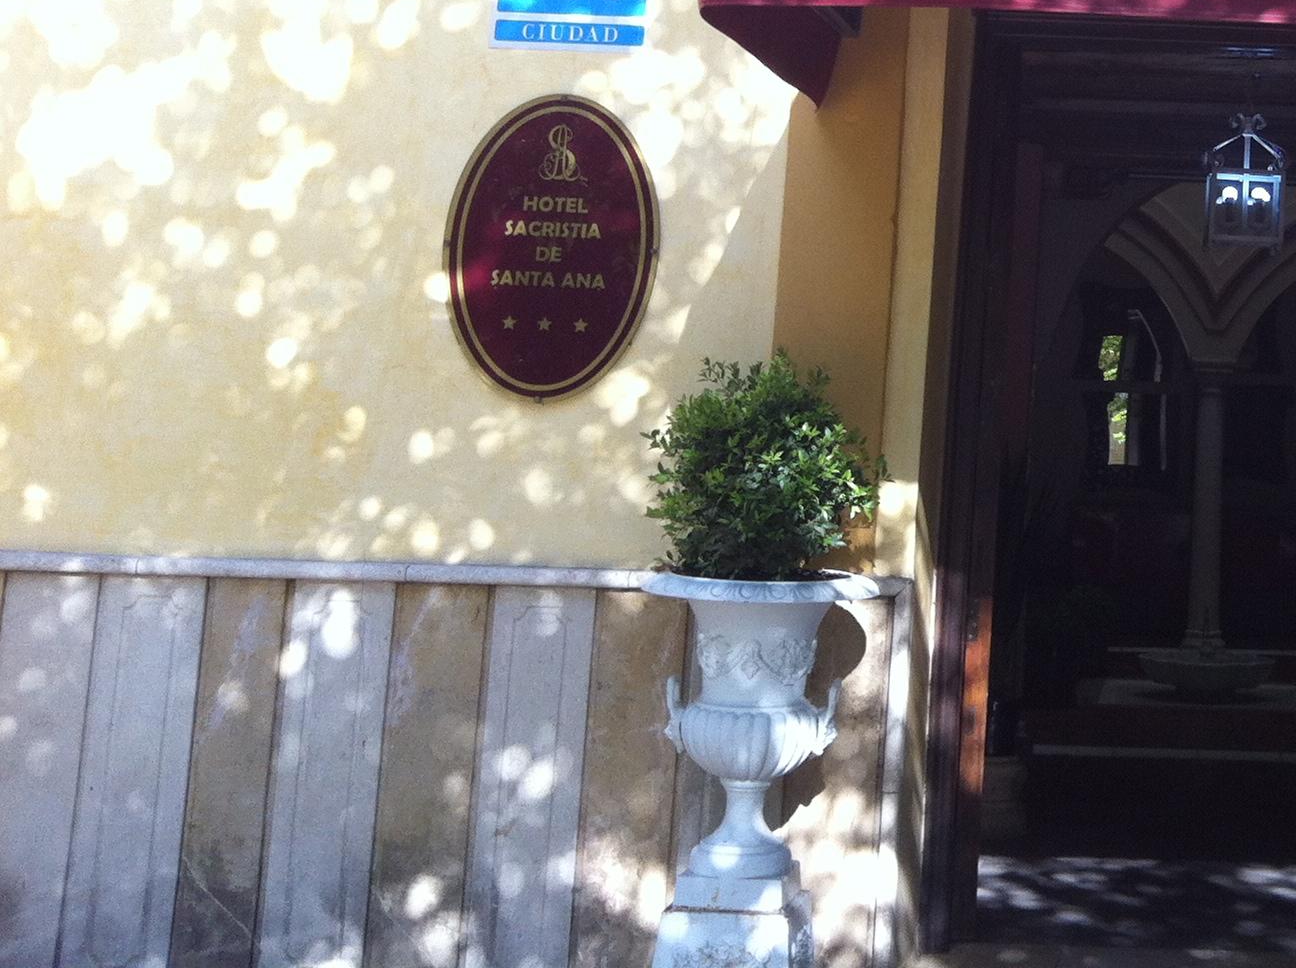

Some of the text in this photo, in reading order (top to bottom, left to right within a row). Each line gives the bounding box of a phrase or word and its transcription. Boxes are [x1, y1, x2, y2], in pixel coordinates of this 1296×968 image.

[521, 22, 619, 43] CIUDAD
[523, 195, 588, 214] HOTEL
[504, 219, 601, 239] SACRISTIA
[535, 245, 562, 262] DE
[490, 269, 606, 289] SANTA ANA
